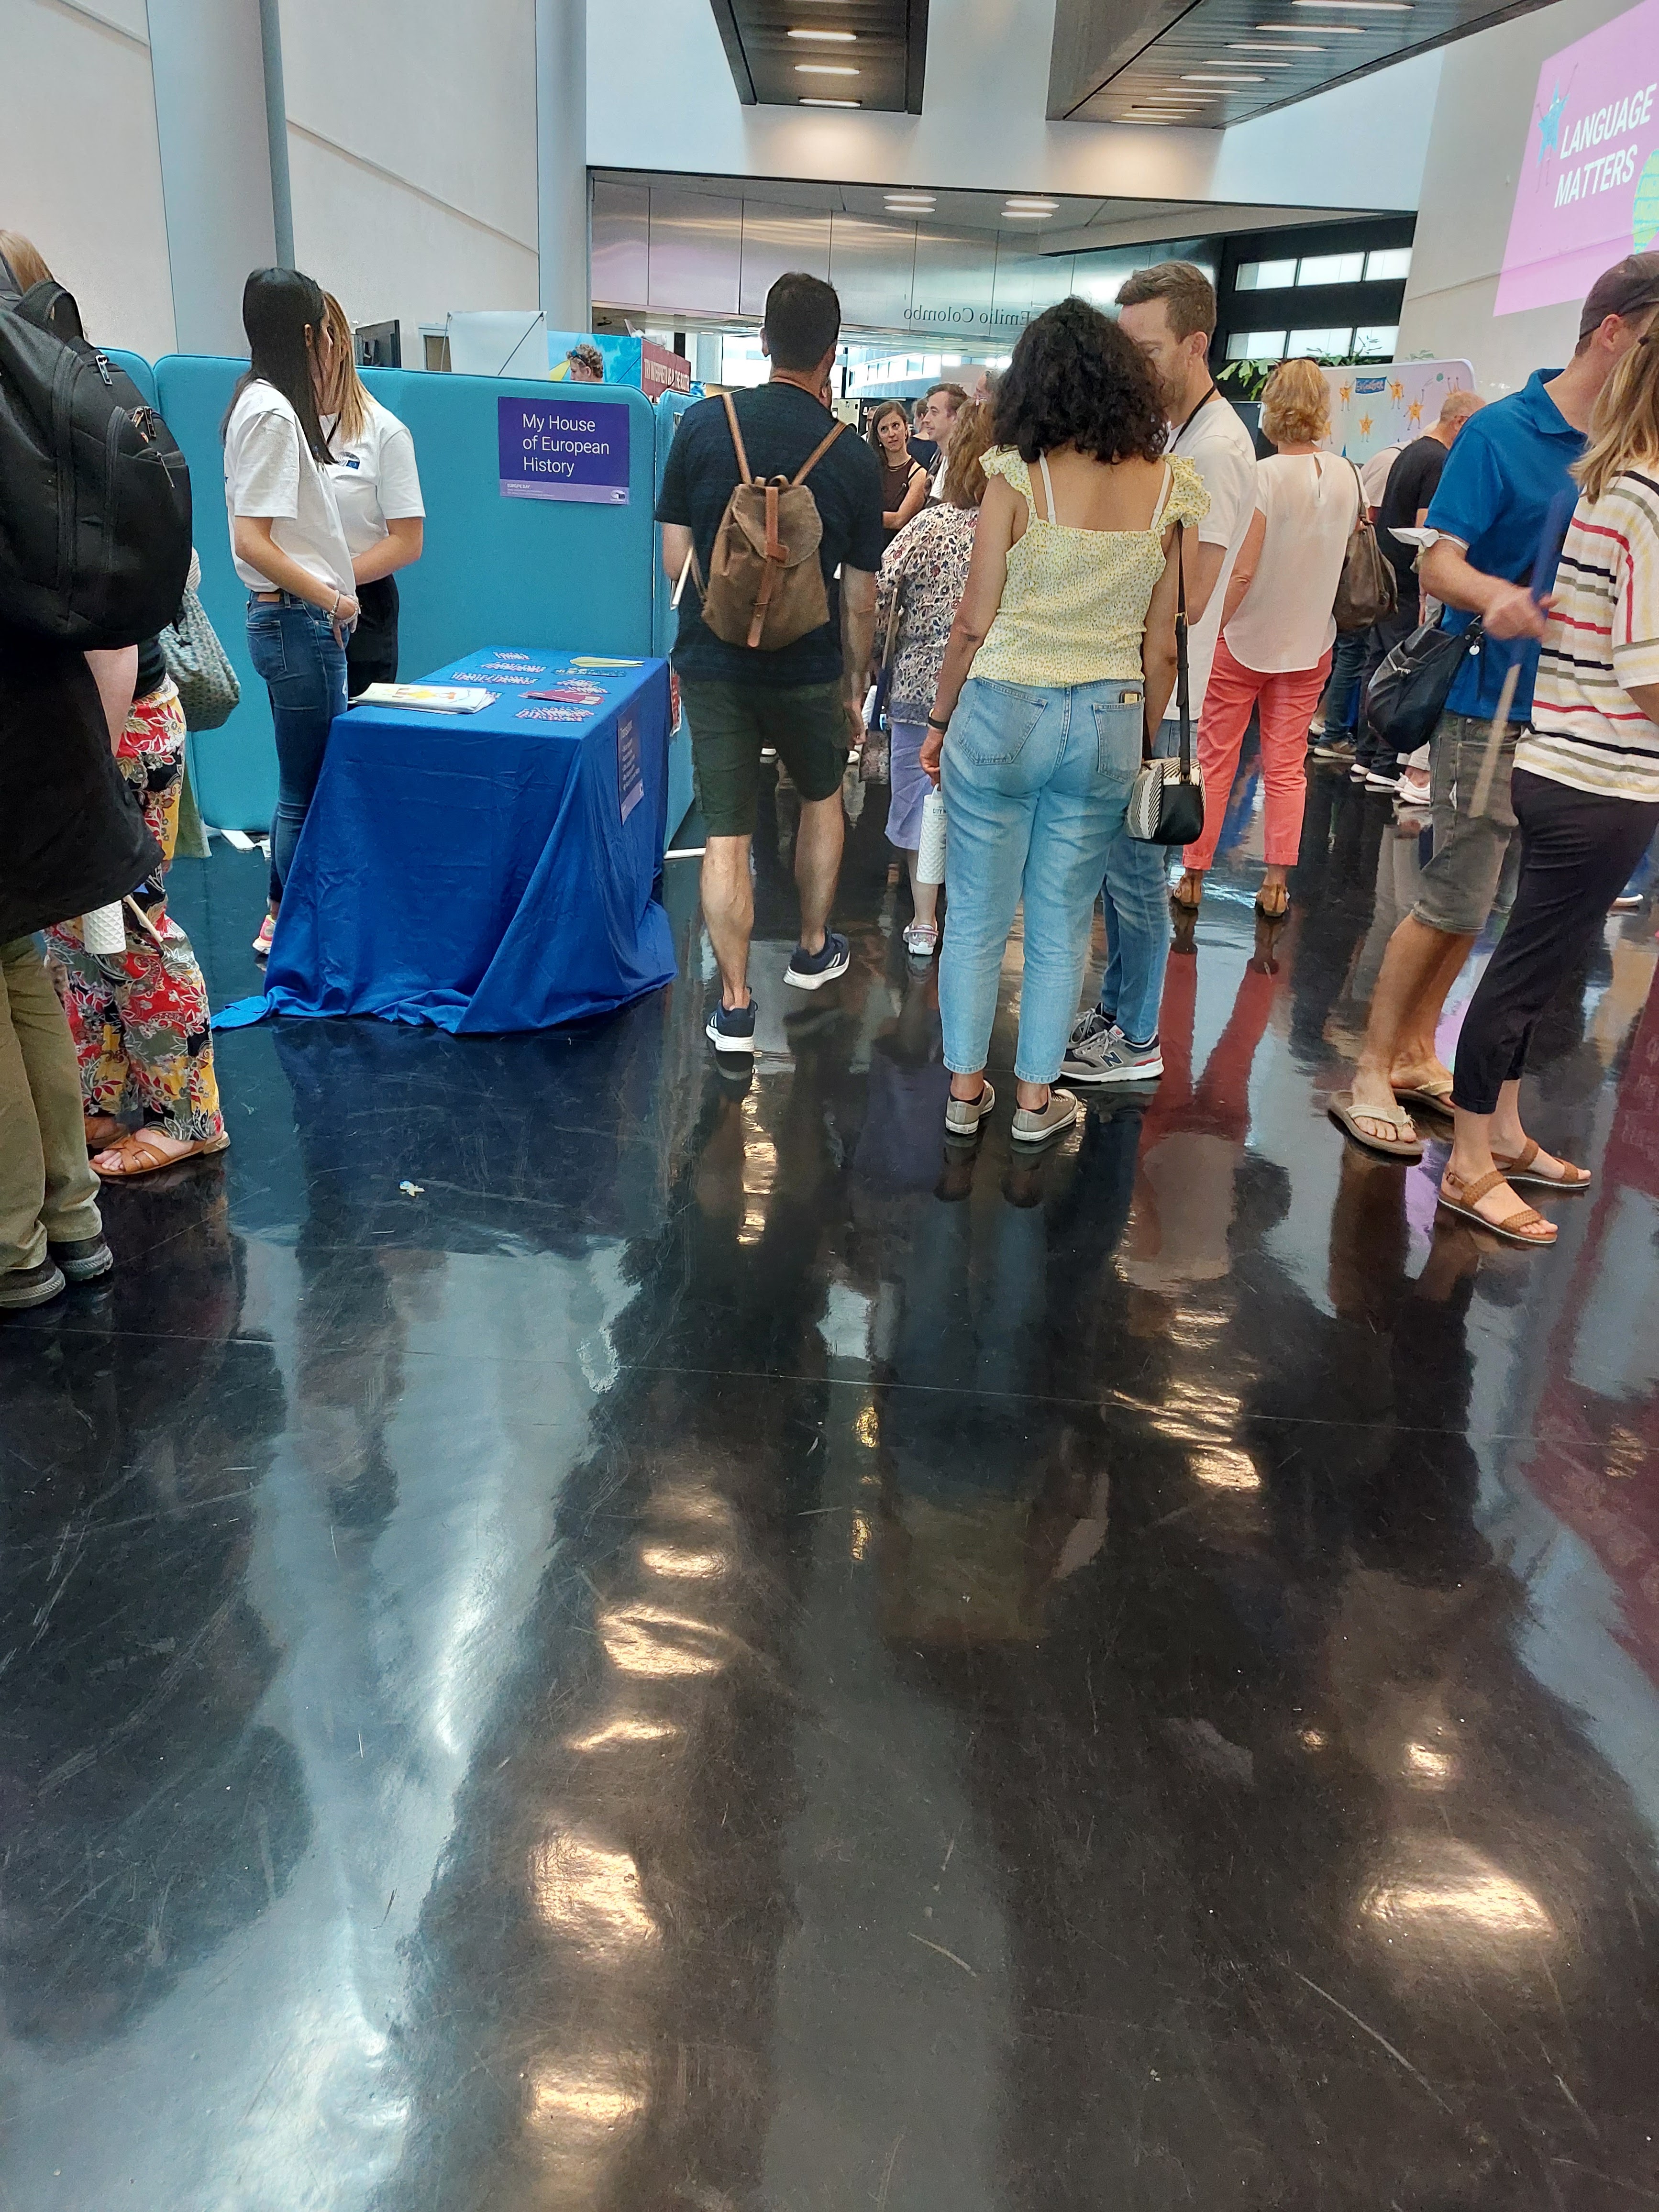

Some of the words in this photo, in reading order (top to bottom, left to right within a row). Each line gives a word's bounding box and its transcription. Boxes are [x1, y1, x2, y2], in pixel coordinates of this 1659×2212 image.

[1560, 83, 1657, 159] LANGUAGE
[1554, 144, 1637, 209] MATTERS
[523, 413, 545, 432] My
[549, 415, 596, 432] House
[523, 435, 538, 451] of
[542, 436, 609, 456] European
[524, 456, 575, 477] History
